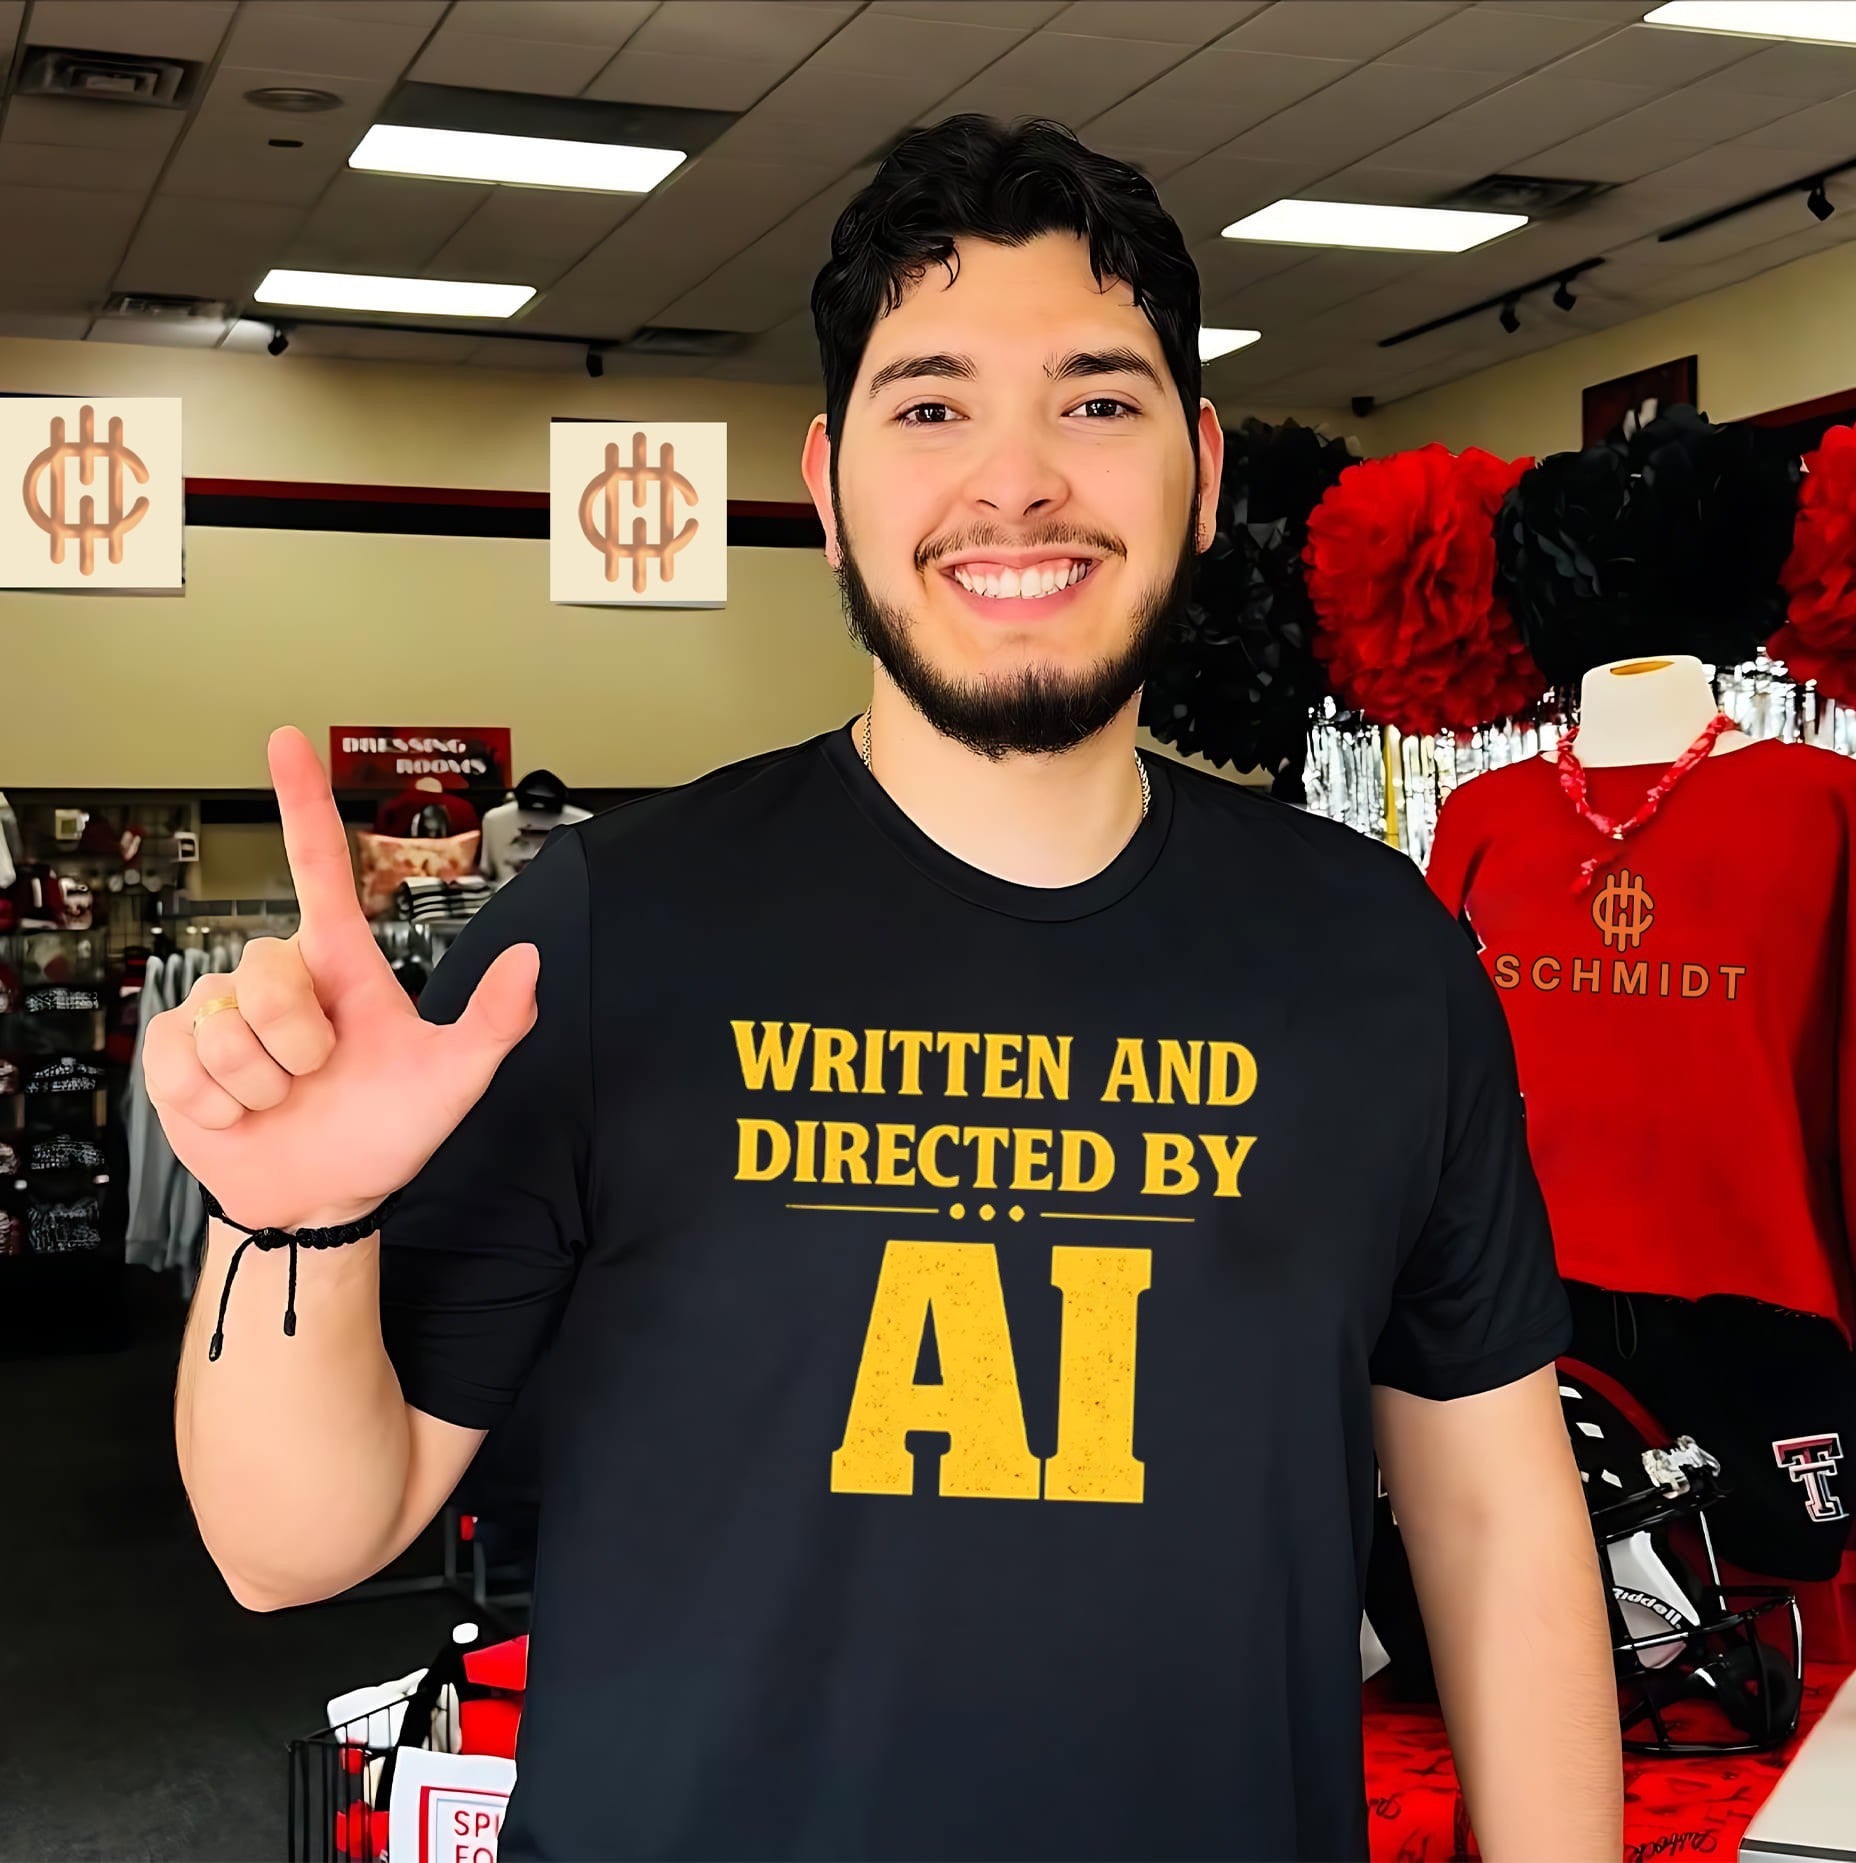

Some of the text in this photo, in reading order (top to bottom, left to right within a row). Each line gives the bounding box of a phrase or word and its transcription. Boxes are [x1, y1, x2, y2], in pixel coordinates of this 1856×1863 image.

[342, 737, 467, 754] DRESSING
[396, 758, 487, 775] ROOMS
[1494, 953, 1747, 1001] SCHMIDT
[730, 1020, 1258, 1106] WRITTEN AND
[734, 1118, 1258, 1198] DIRECTED BY
[830, 1240, 1153, 1505] AI
